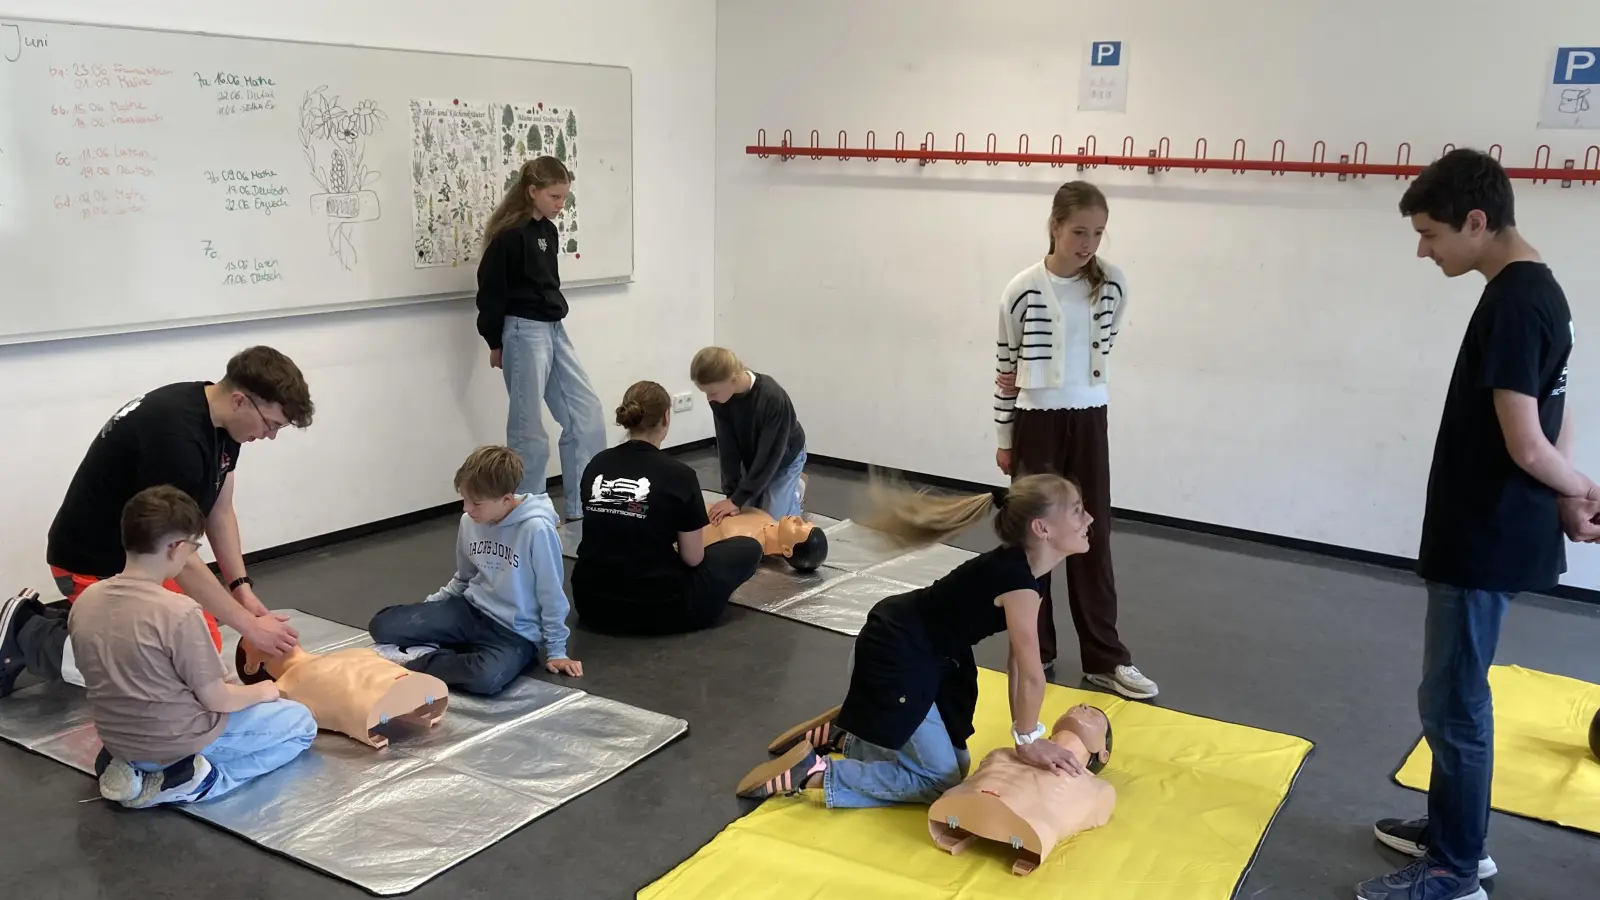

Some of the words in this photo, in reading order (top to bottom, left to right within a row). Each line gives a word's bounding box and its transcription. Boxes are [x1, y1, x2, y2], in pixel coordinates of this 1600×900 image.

[1, 23, 48, 62] Juni
[1097, 44, 1115, 64] P
[1564, 51, 1596, 80] P
[243, 75, 277, 87] Mathe
[250, 169, 278, 180] Mathe
